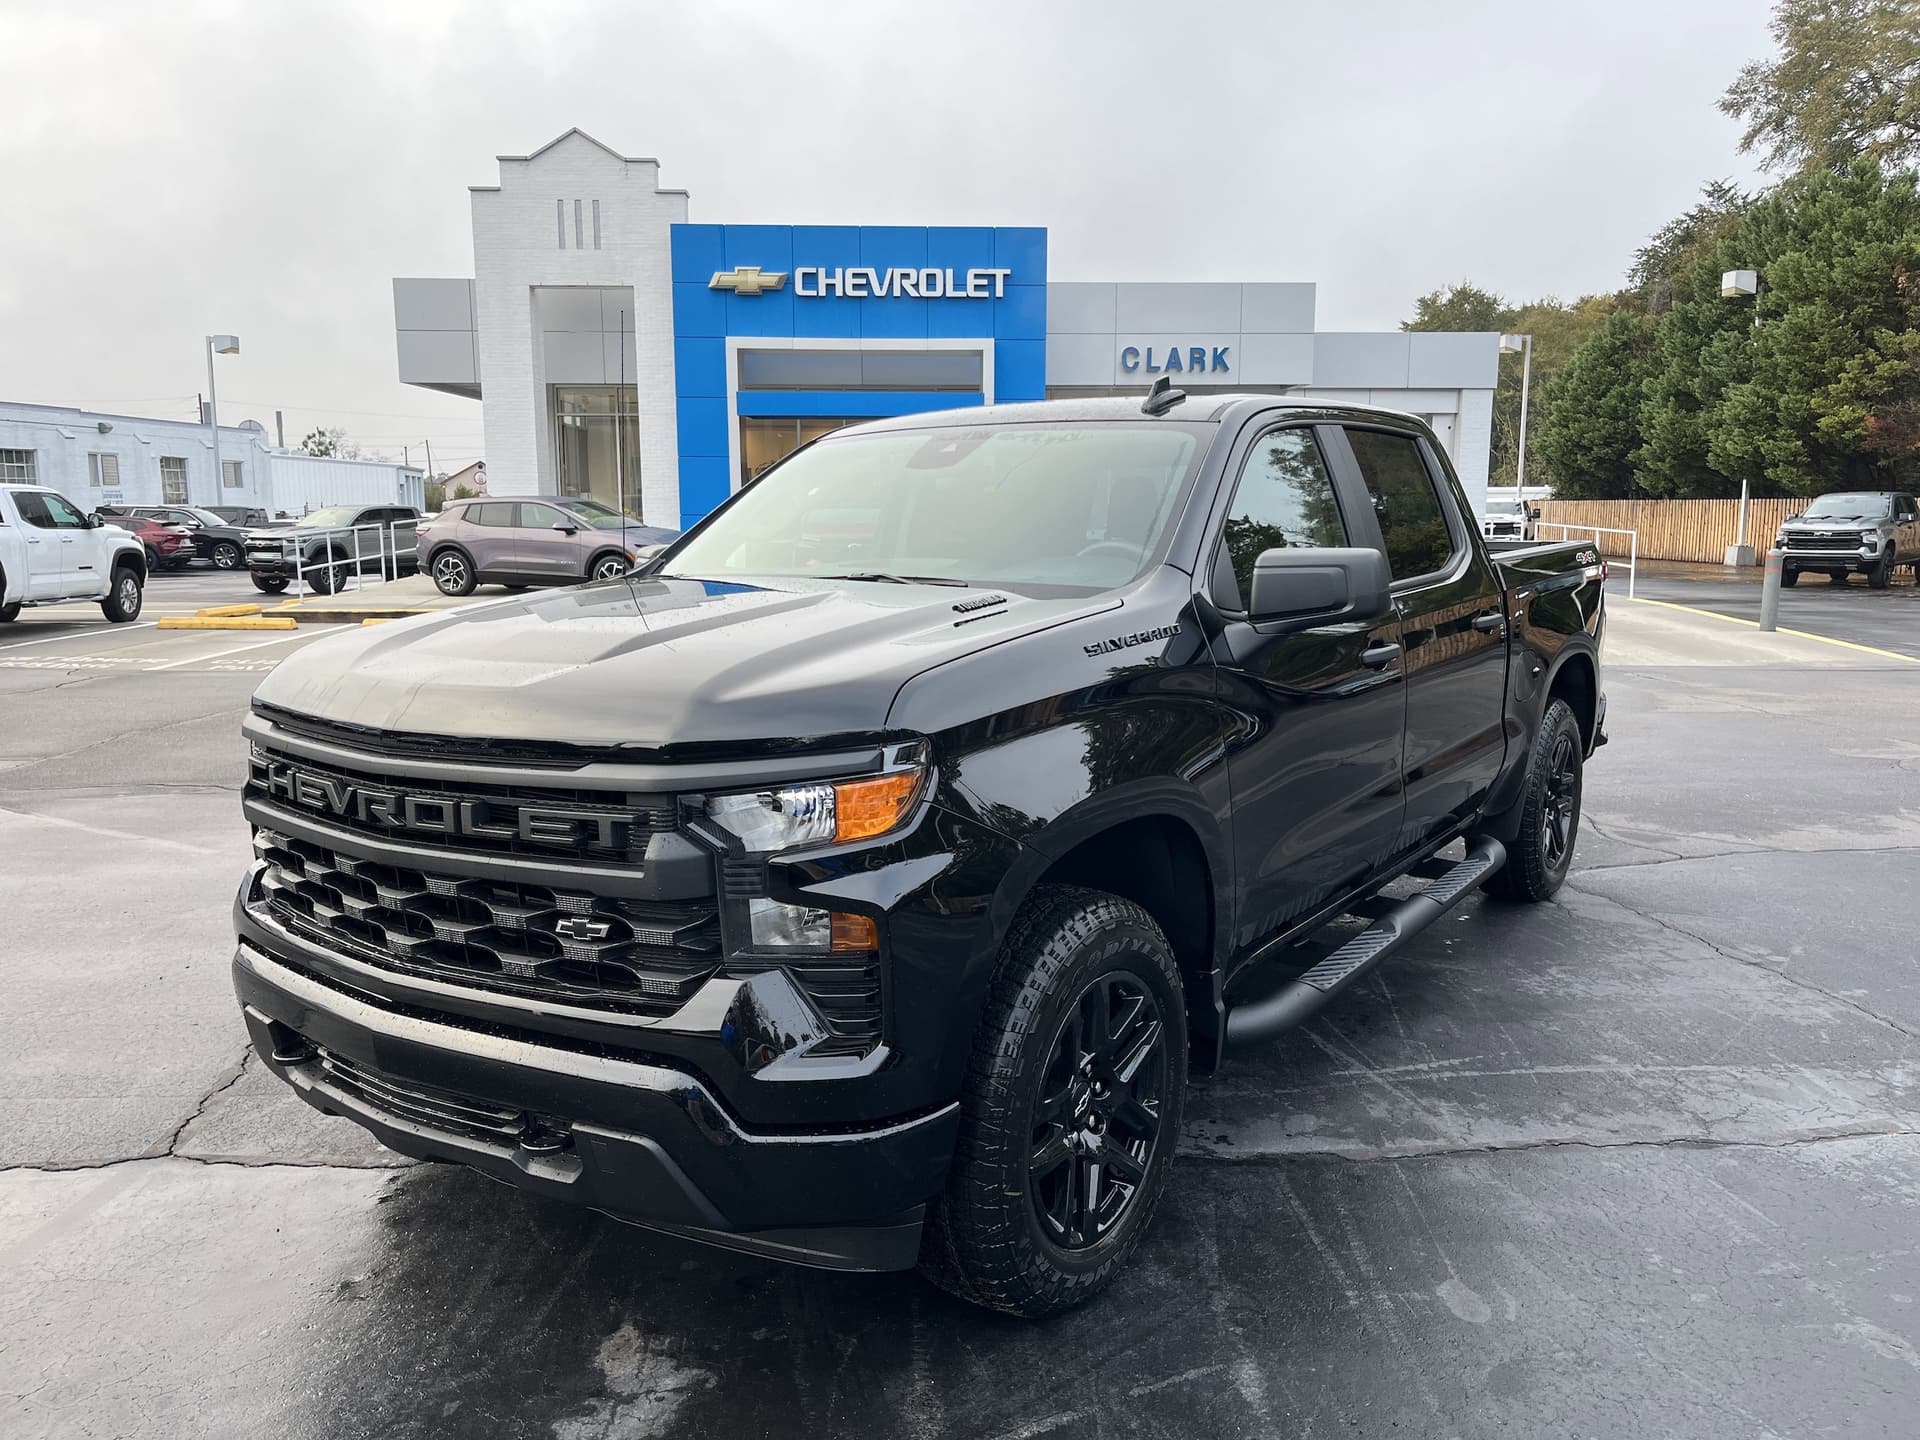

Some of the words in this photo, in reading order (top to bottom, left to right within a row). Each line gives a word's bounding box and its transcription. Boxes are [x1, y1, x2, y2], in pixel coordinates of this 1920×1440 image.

[794, 267, 1011, 298] CHEVROLET
[1121, 346, 1230, 373] CLARK
[1083, 623, 1183, 658] SILVERADO
[248, 755, 649, 849] CHEVROLET
